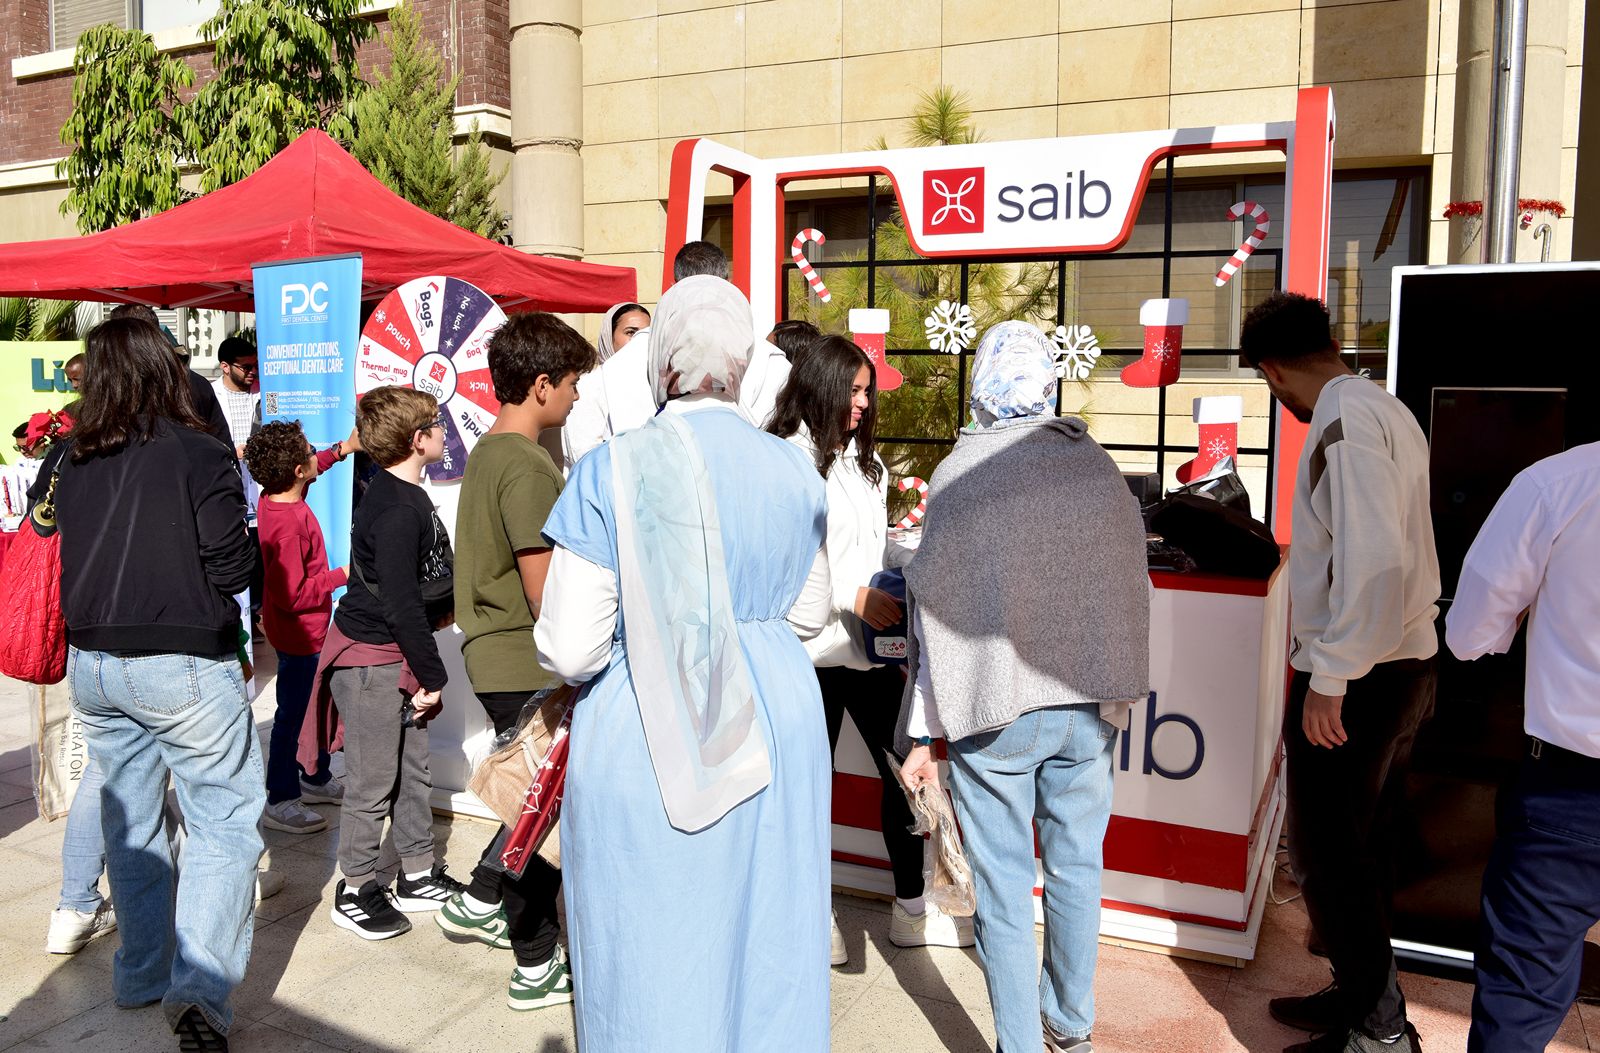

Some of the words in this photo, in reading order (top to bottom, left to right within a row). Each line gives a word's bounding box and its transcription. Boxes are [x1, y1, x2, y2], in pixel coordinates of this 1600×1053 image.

[997, 170, 1112, 223] saib
[281, 282, 329, 315] FDC
[458, 295, 471, 310] No
[292, 315, 310, 323] DENTAL
[419, 290, 434, 329] Bags
[452, 314, 466, 331] luck
[385, 322, 412, 351] pouch
[266, 344, 303, 360] CONVENIENT
[304, 341, 341, 358] LOCATIONS,
[465, 346, 482, 359] bag
[31, 358, 75, 393] Li
[263, 360, 301, 376] EXCEPTIONAL
[302, 358, 327, 374] DENTAL
[327, 358, 344, 373] CARE
[361, 360, 391, 373] Thermal
[393, 368, 408, 378] mug
[419, 378, 444, 400] saib
[469, 381, 489, 394] luck
[460, 411, 484, 439] ndle
[1120, 691, 1205, 780] ib
